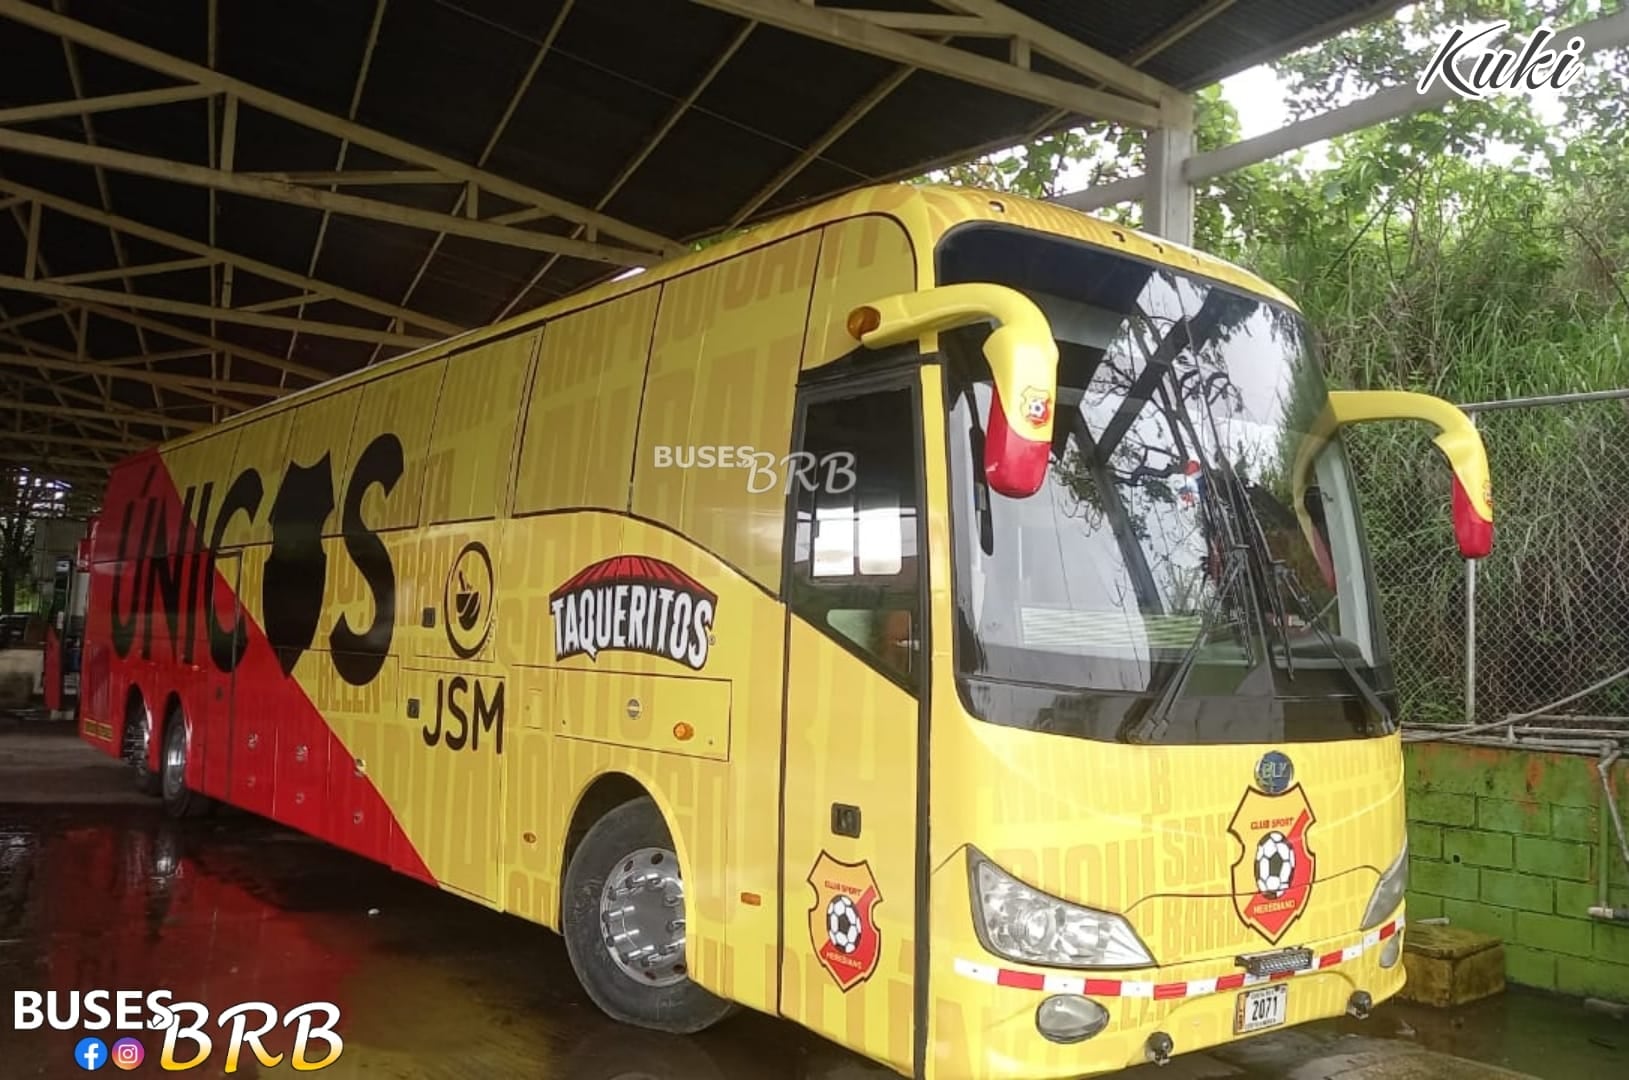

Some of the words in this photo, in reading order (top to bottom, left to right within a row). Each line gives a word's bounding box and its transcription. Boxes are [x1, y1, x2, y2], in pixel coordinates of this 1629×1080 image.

[551, 585, 713, 668] TAQUERITOS
[422, 676, 505, 754] JSM
[1250, 819, 1270, 830] CLUB
[1271, 817, 1294, 829] SPORT
[1251, 996, 1278, 1021] 2071
